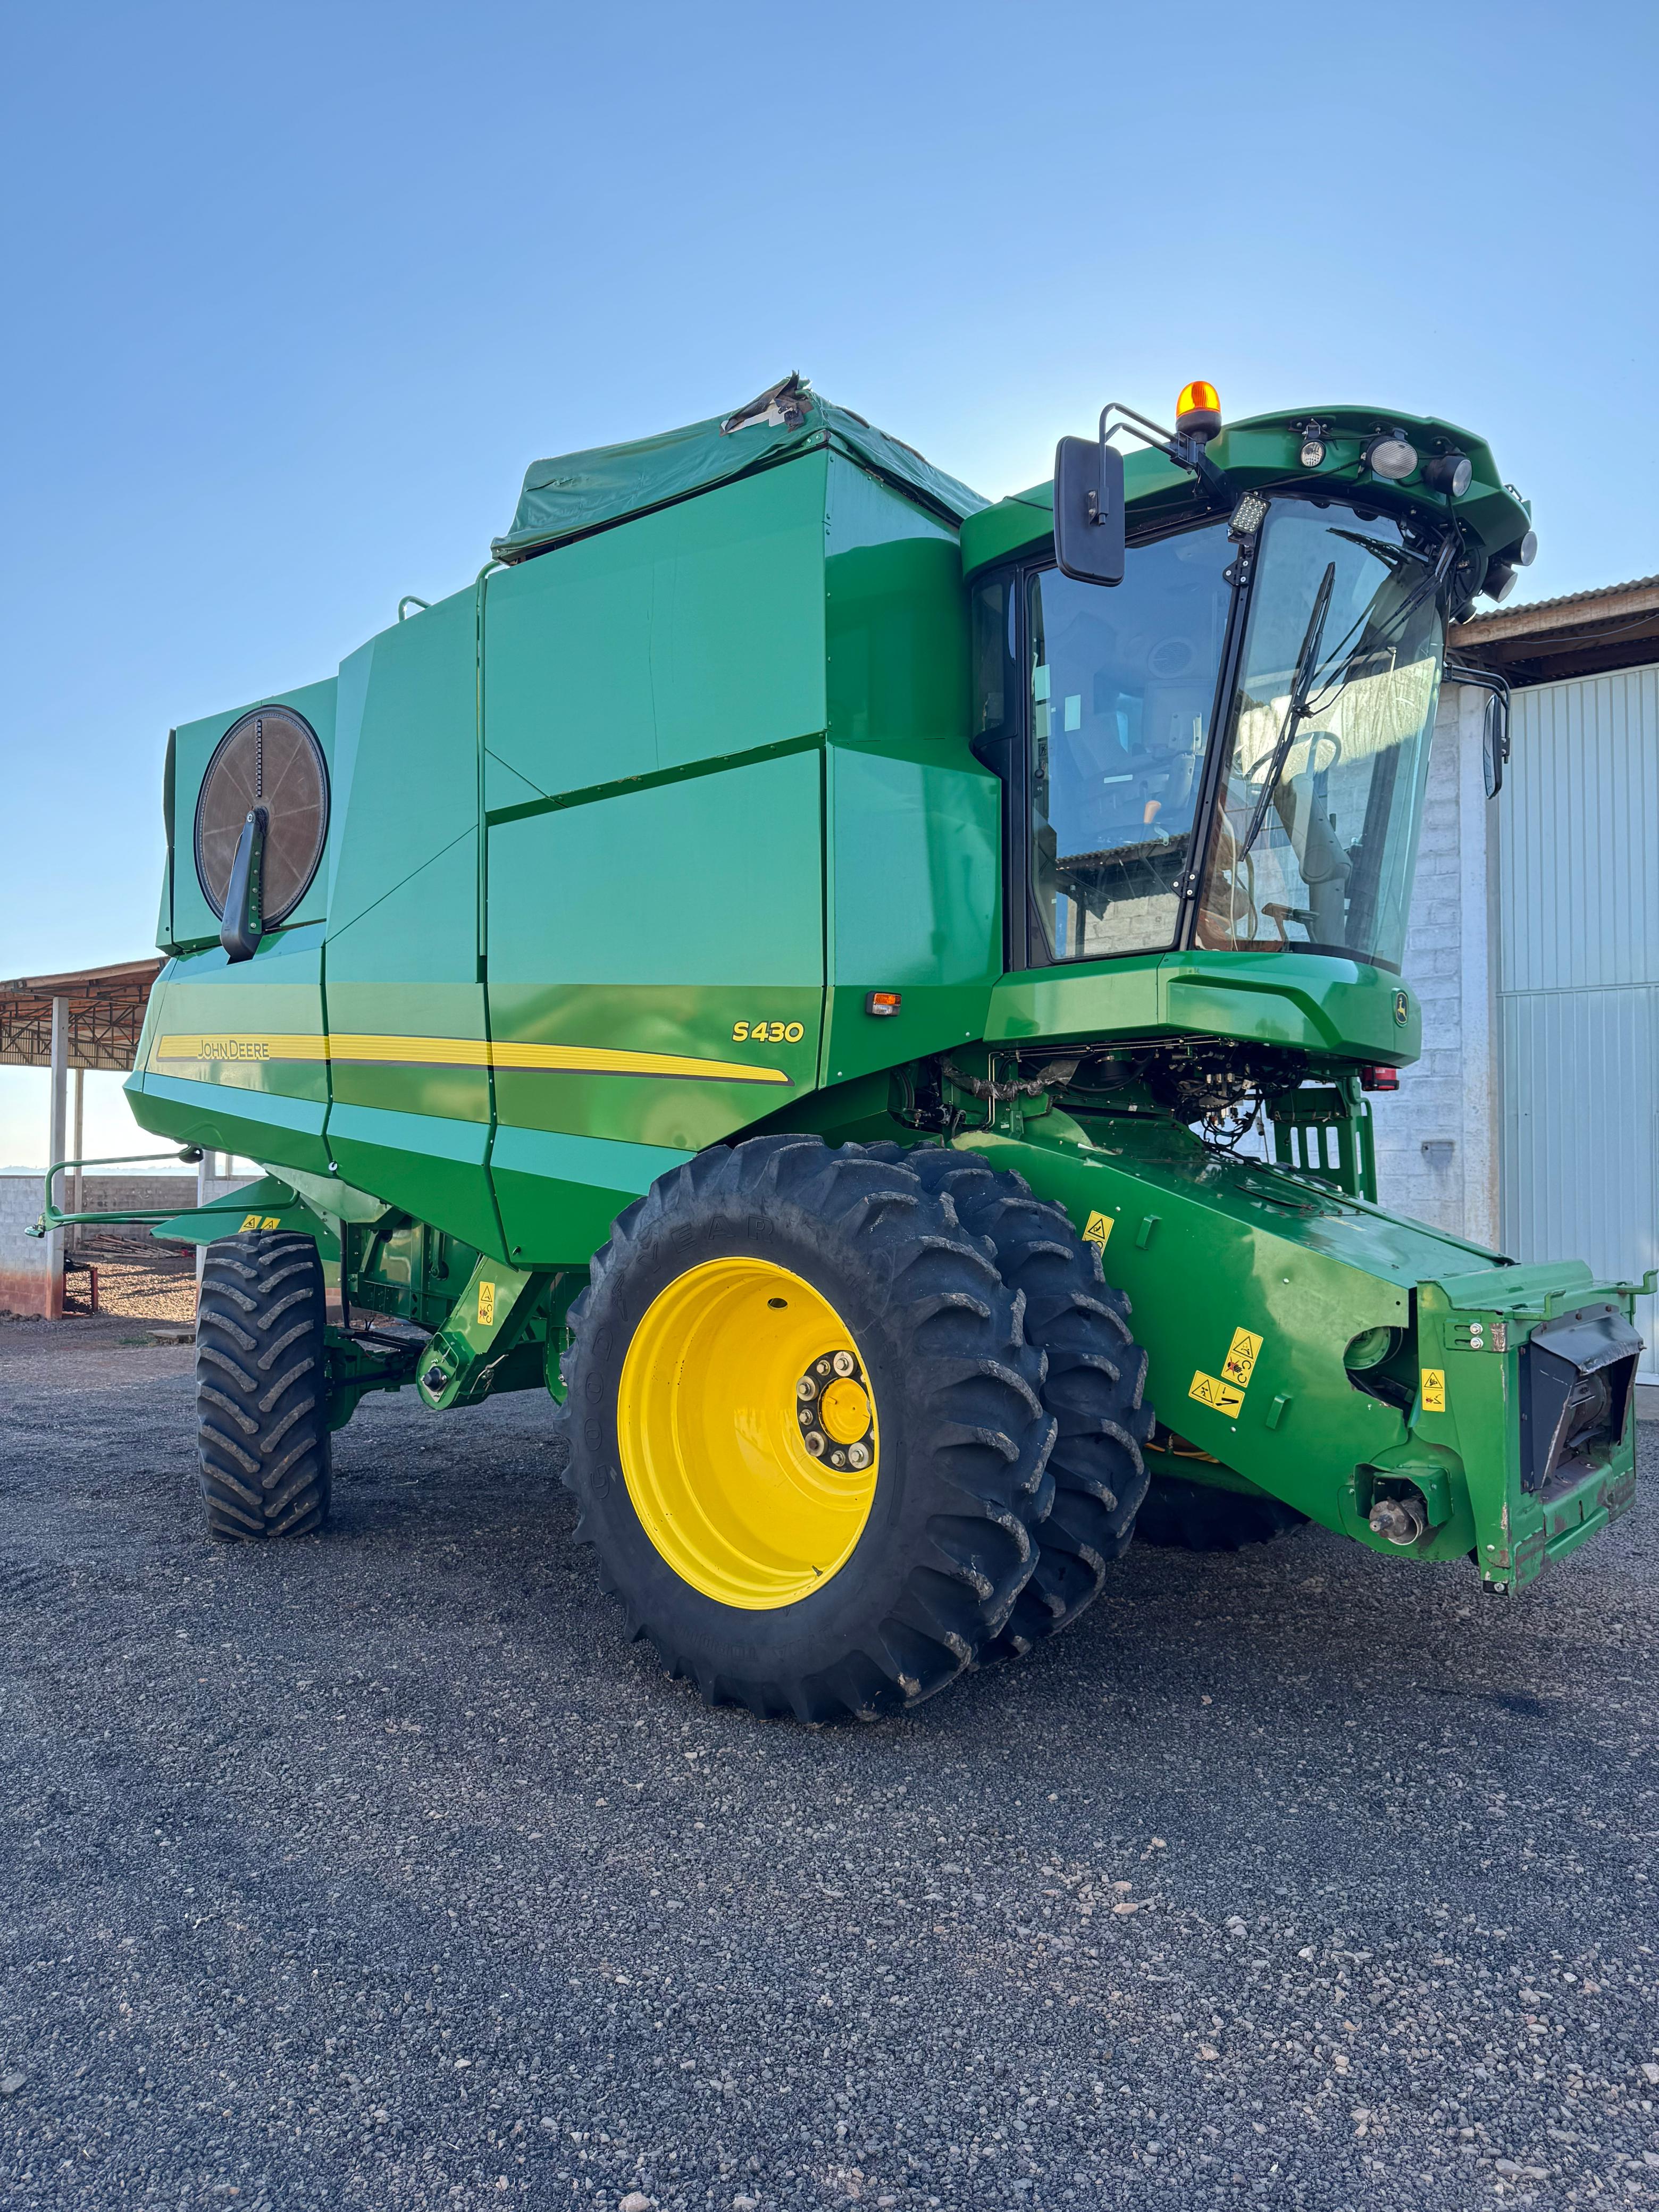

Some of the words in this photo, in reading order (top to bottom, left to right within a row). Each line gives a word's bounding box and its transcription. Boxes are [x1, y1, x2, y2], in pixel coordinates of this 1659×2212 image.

[732, 1021, 805, 1043] S430
[198, 1039, 228, 1057] JOHN
[229, 1039, 270, 1058] DEERE
